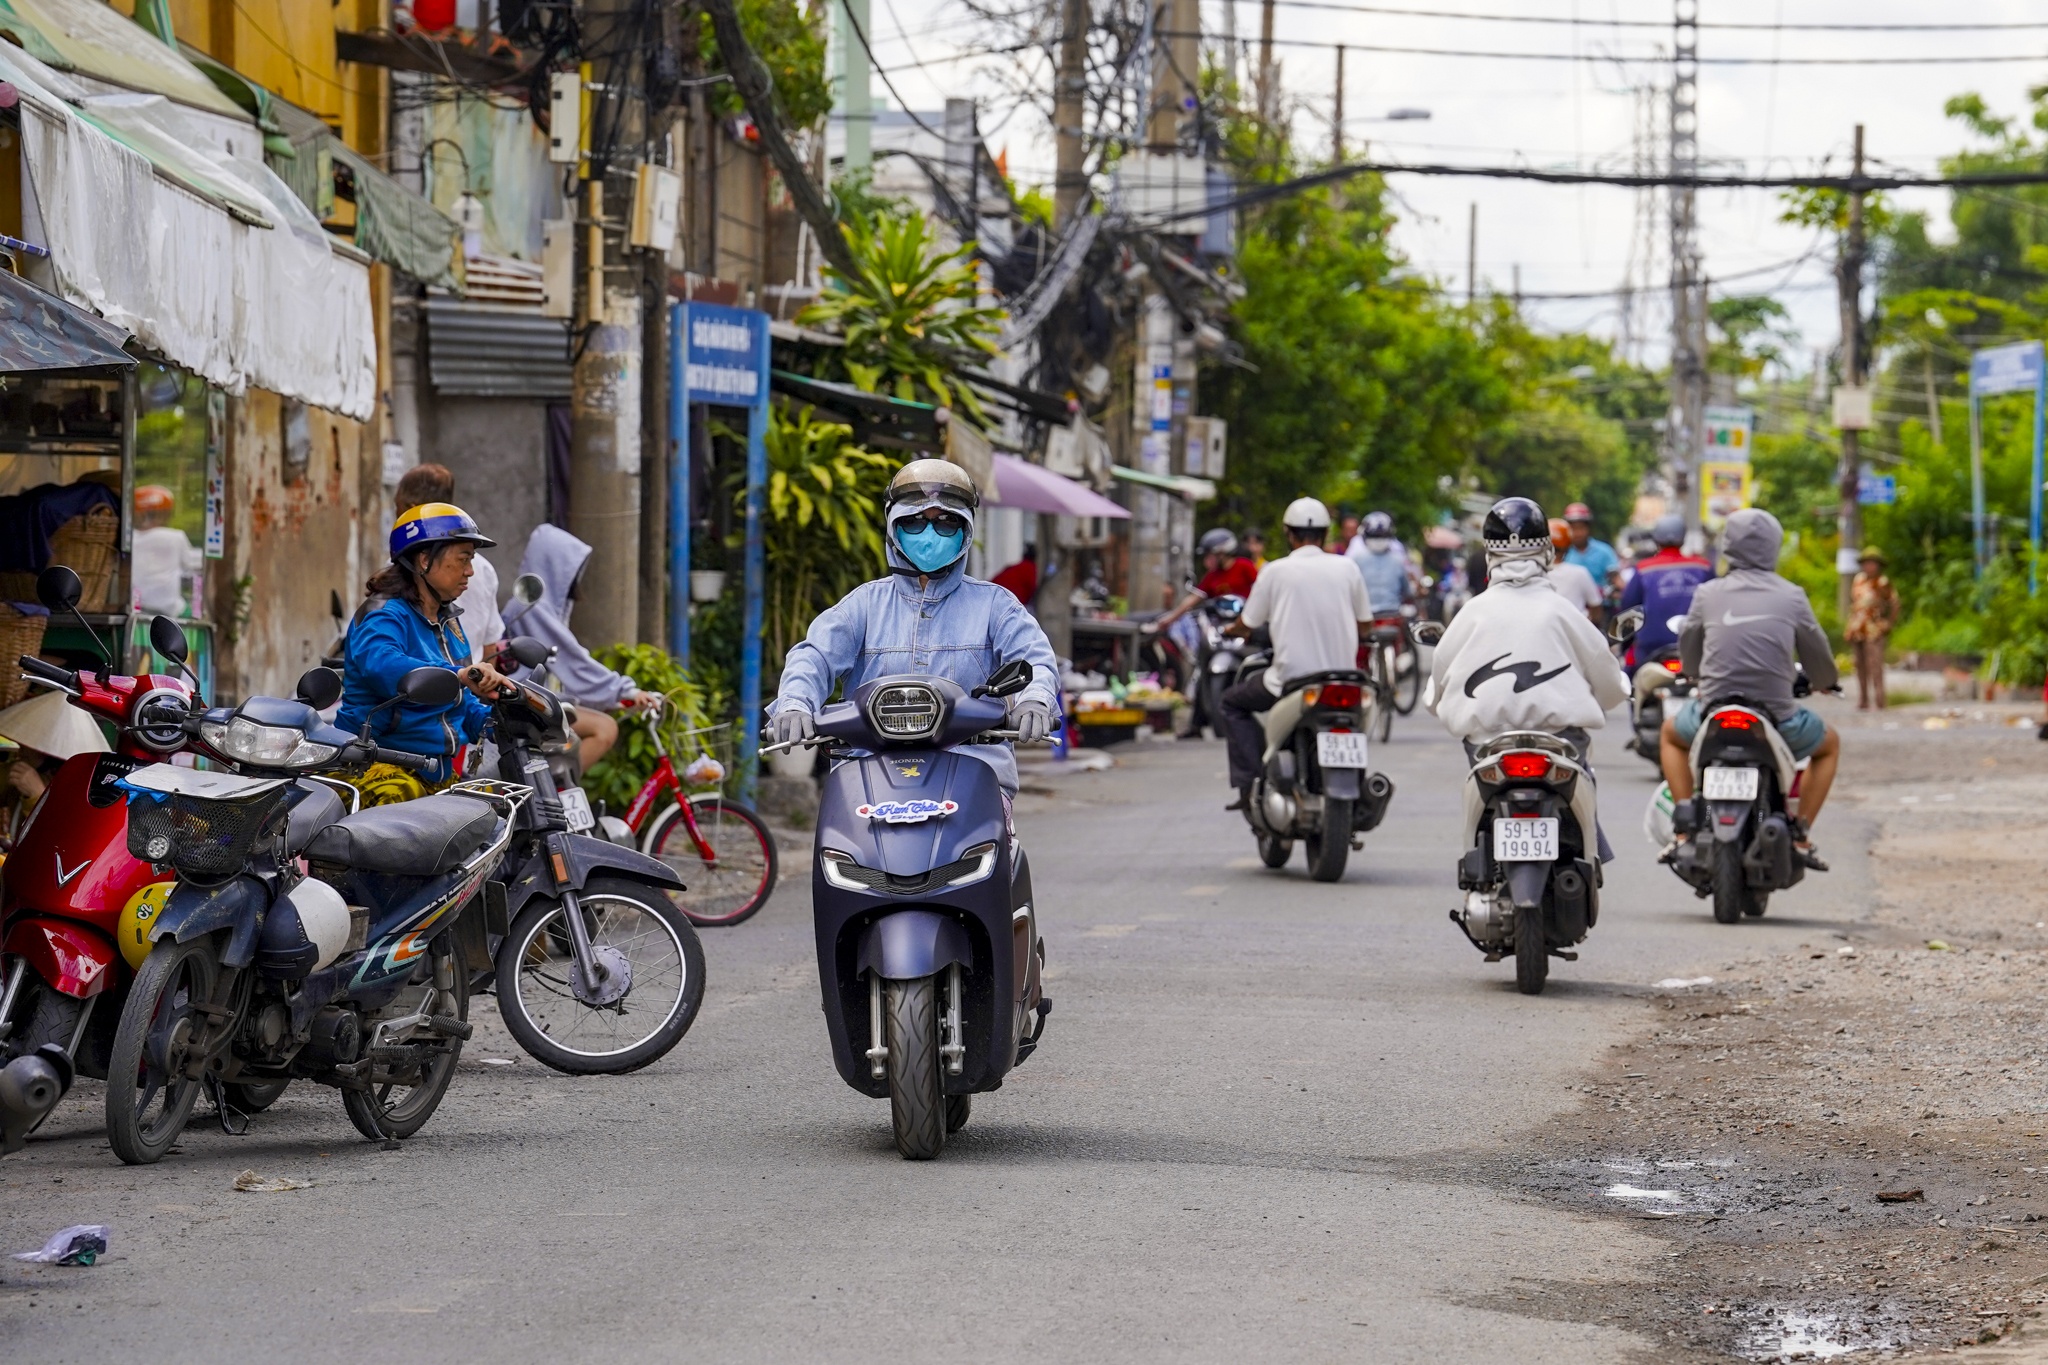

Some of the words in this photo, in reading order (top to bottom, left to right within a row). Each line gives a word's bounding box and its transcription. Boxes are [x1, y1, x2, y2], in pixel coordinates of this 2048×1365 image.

[102, 760, 136, 772] VINFAST
[1504, 821, 1548, 839] 59-L3
[1501, 840, 1552, 858] 199.94
[668, 1001, 689, 1030] MAXXIS
